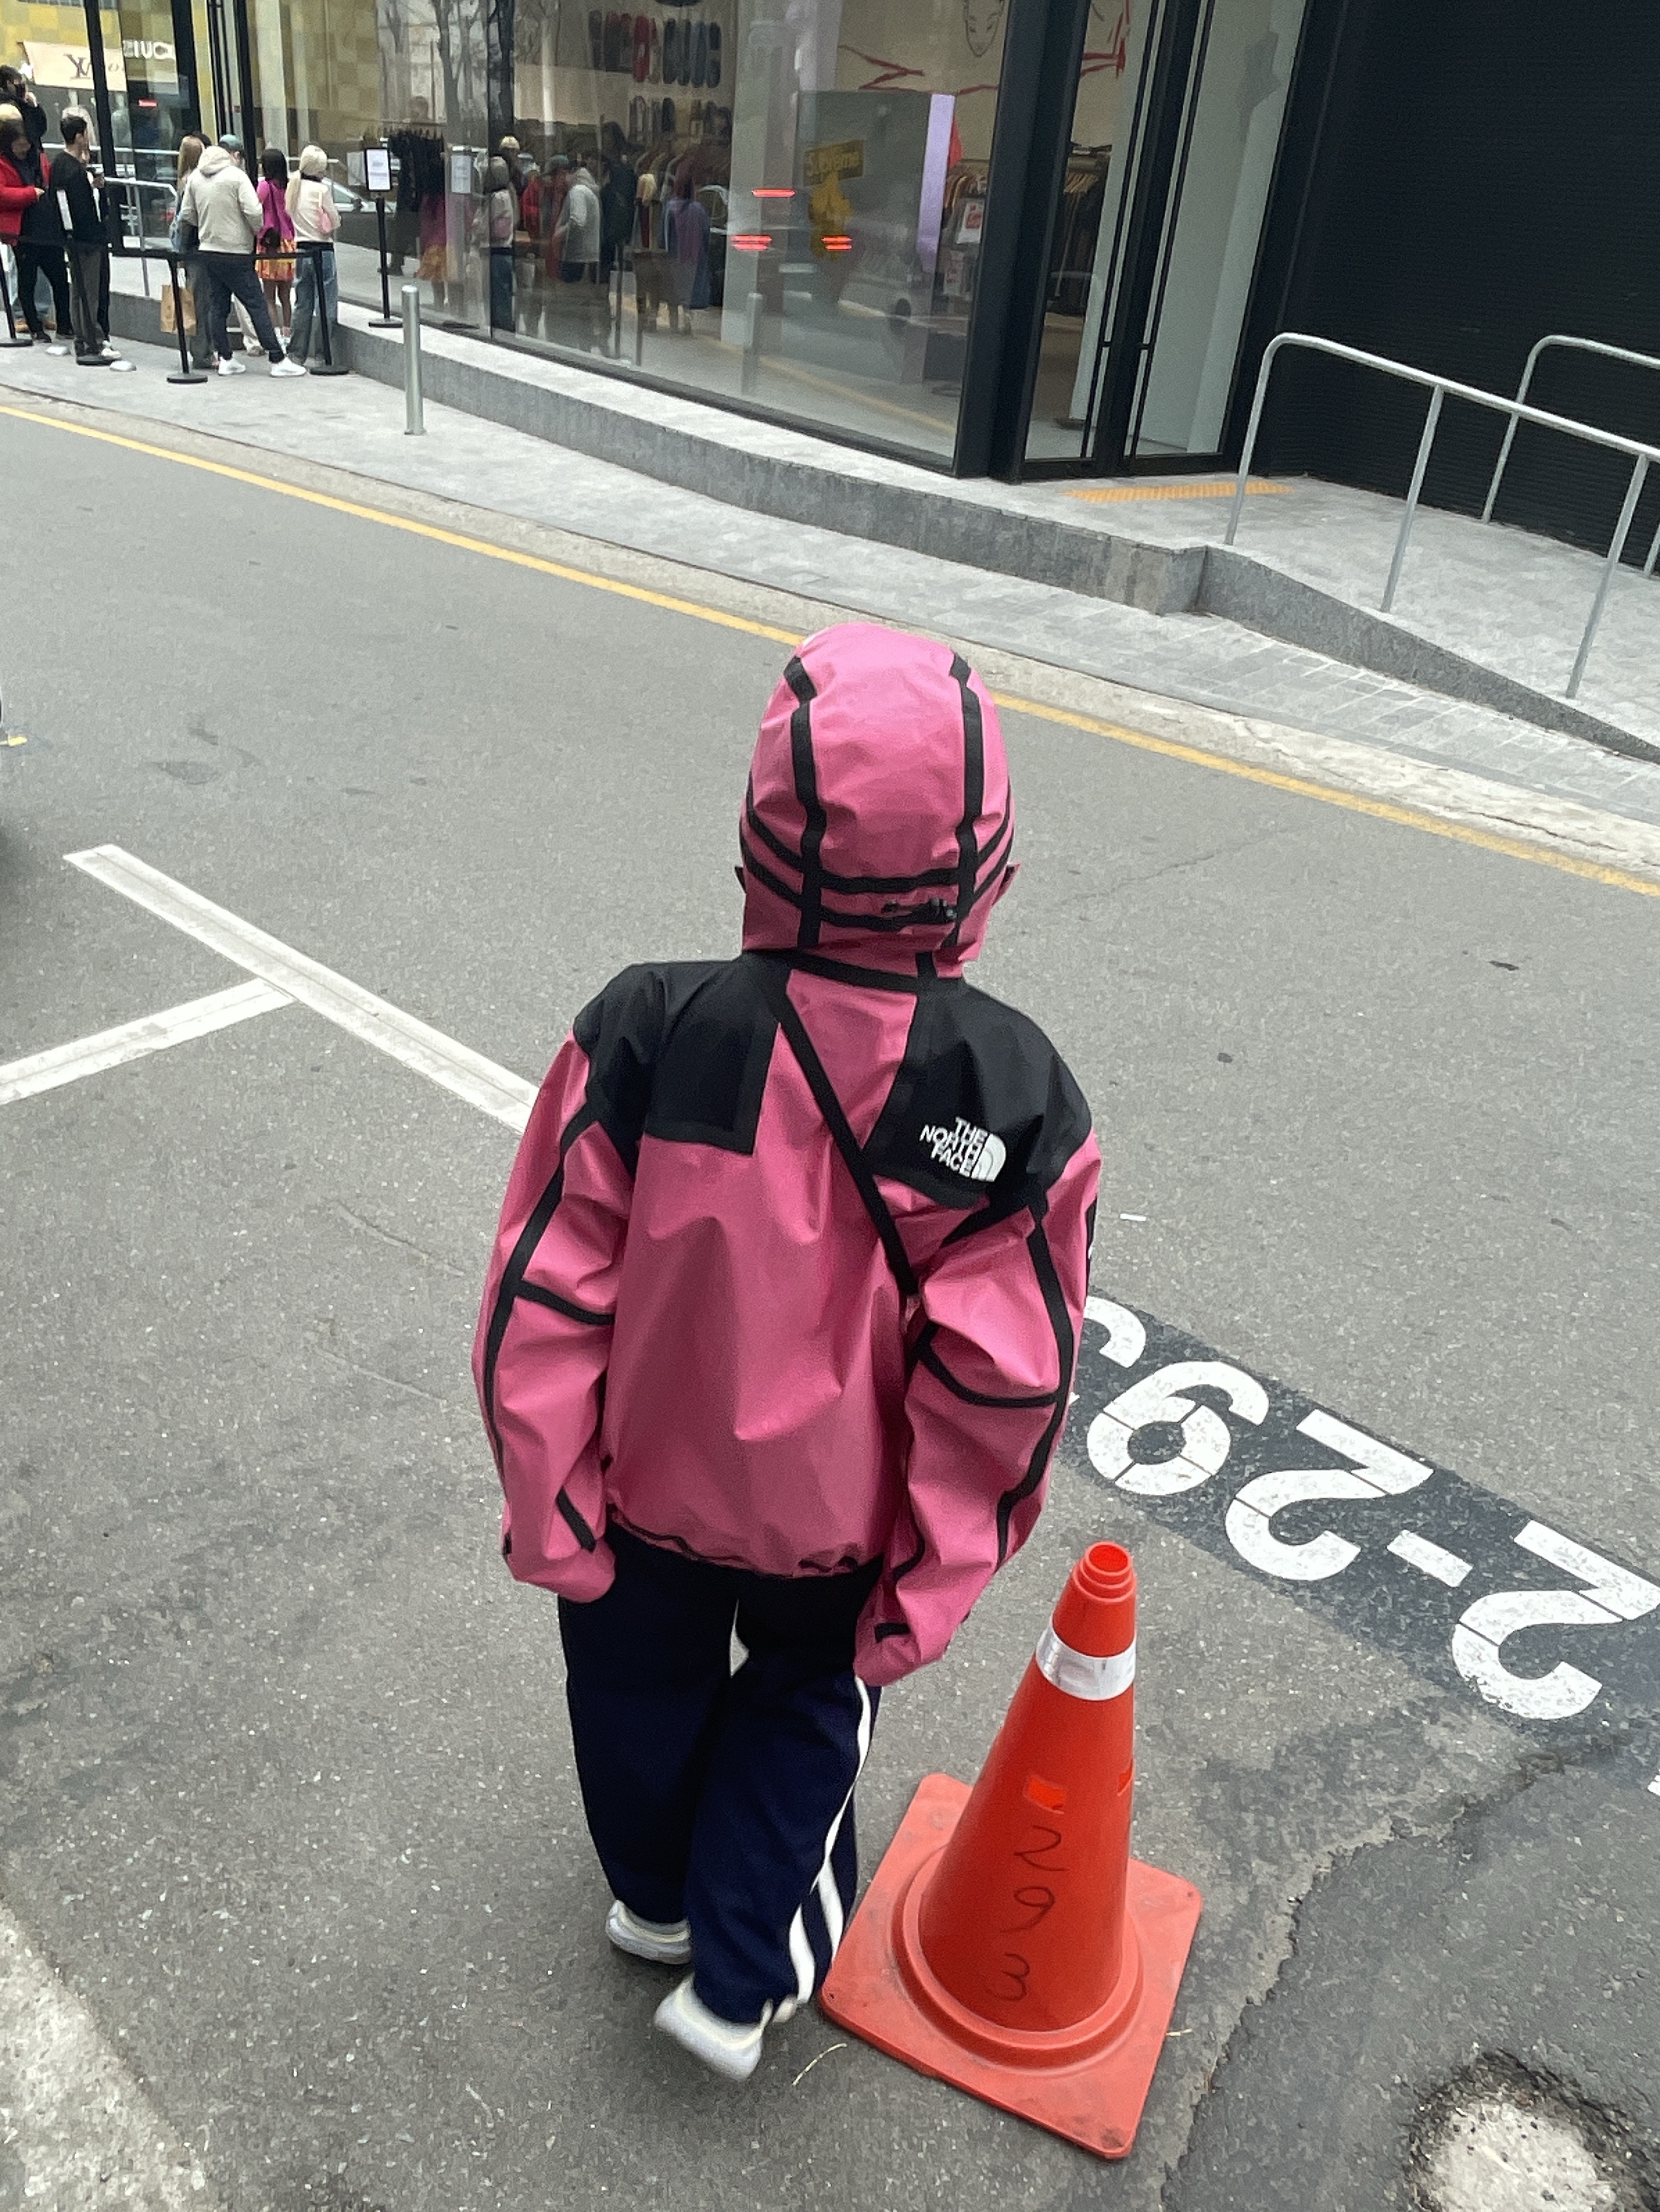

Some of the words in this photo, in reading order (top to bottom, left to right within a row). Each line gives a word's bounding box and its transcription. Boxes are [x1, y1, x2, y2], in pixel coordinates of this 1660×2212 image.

[919, 1124, 983, 1160] NORTH
[956, 1115, 988, 1144] THE
[930, 1142, 974, 1177] FACE
